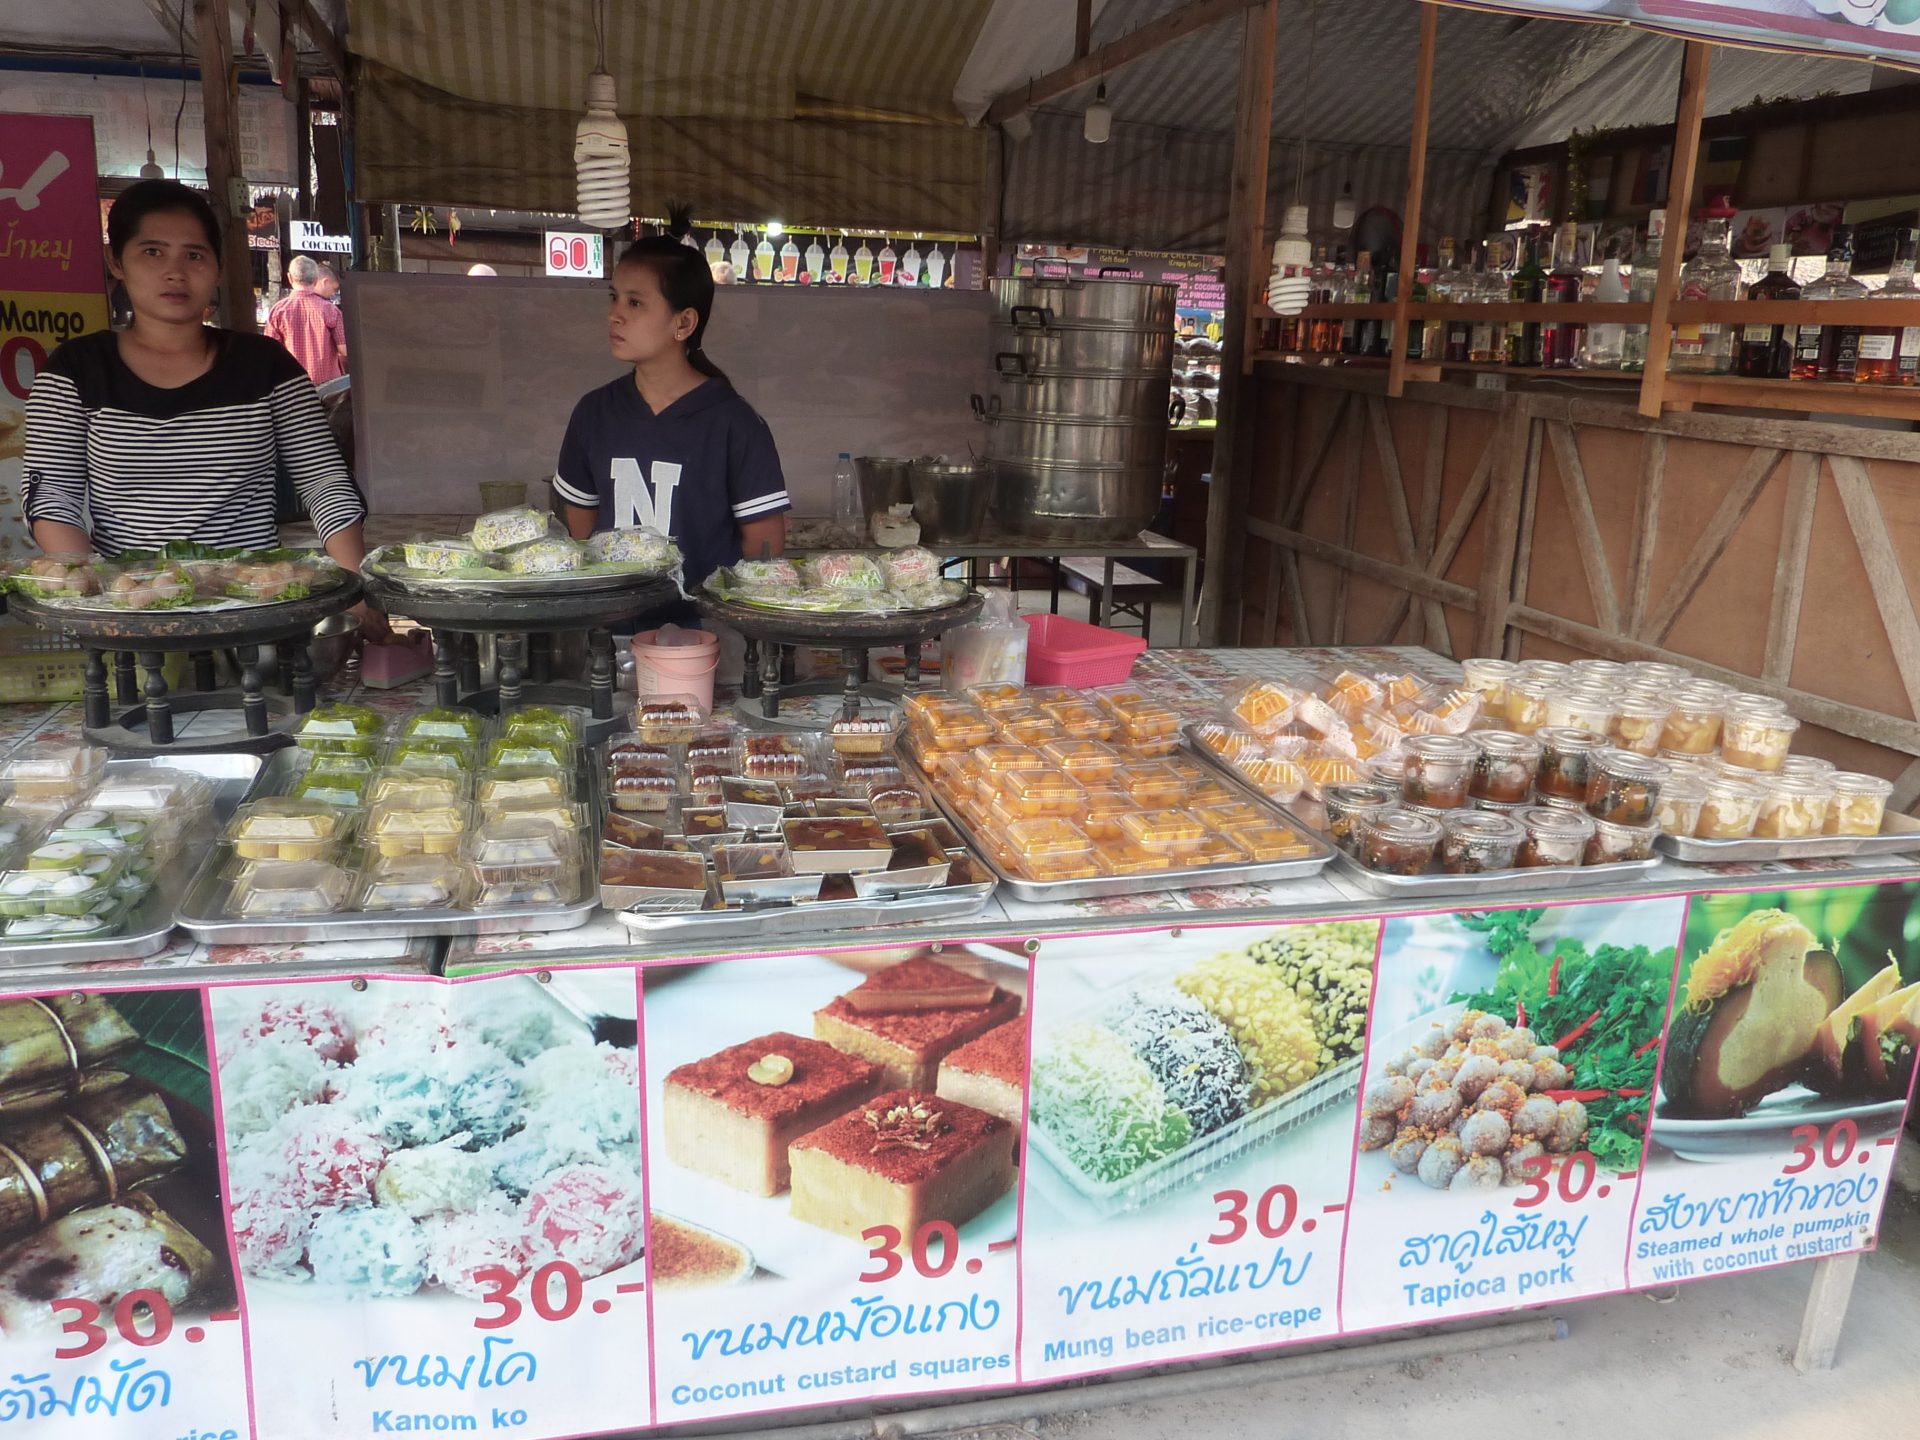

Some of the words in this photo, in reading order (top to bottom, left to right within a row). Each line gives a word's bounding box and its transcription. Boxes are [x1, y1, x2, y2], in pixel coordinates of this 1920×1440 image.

[0, 300, 84, 343] Mango
[610, 457, 682, 543] N
[1637, 1233, 1722, 1259] Steamed
[1731, 1225, 1784, 1245] whole
[1793, 1211, 1870, 1237] pumpkin
[1653, 1258, 1694, 1279] with
[1703, 1244, 1777, 1272] coconut
[1786, 1232, 1852, 1259] custard
[1404, 1276, 1505, 1307] Tapioca
[1519, 1262, 1574, 1295] pork
[682, 1293, 1000, 1360] ขนมหม้อแกง
[1044, 1335, 1113, 1362] Mung
[1126, 1323, 1185, 1348] bean
[1198, 1307, 1322, 1337] rice-crepe
[353, 1336, 537, 1390] ขนมโค
[671, 1374, 786, 1406] Coconut
[798, 1360, 897, 1390] custard
[909, 1352, 1011, 1378] squares
[373, 1410, 477, 1433] Kanom
[492, 1408, 528, 1429] ko
